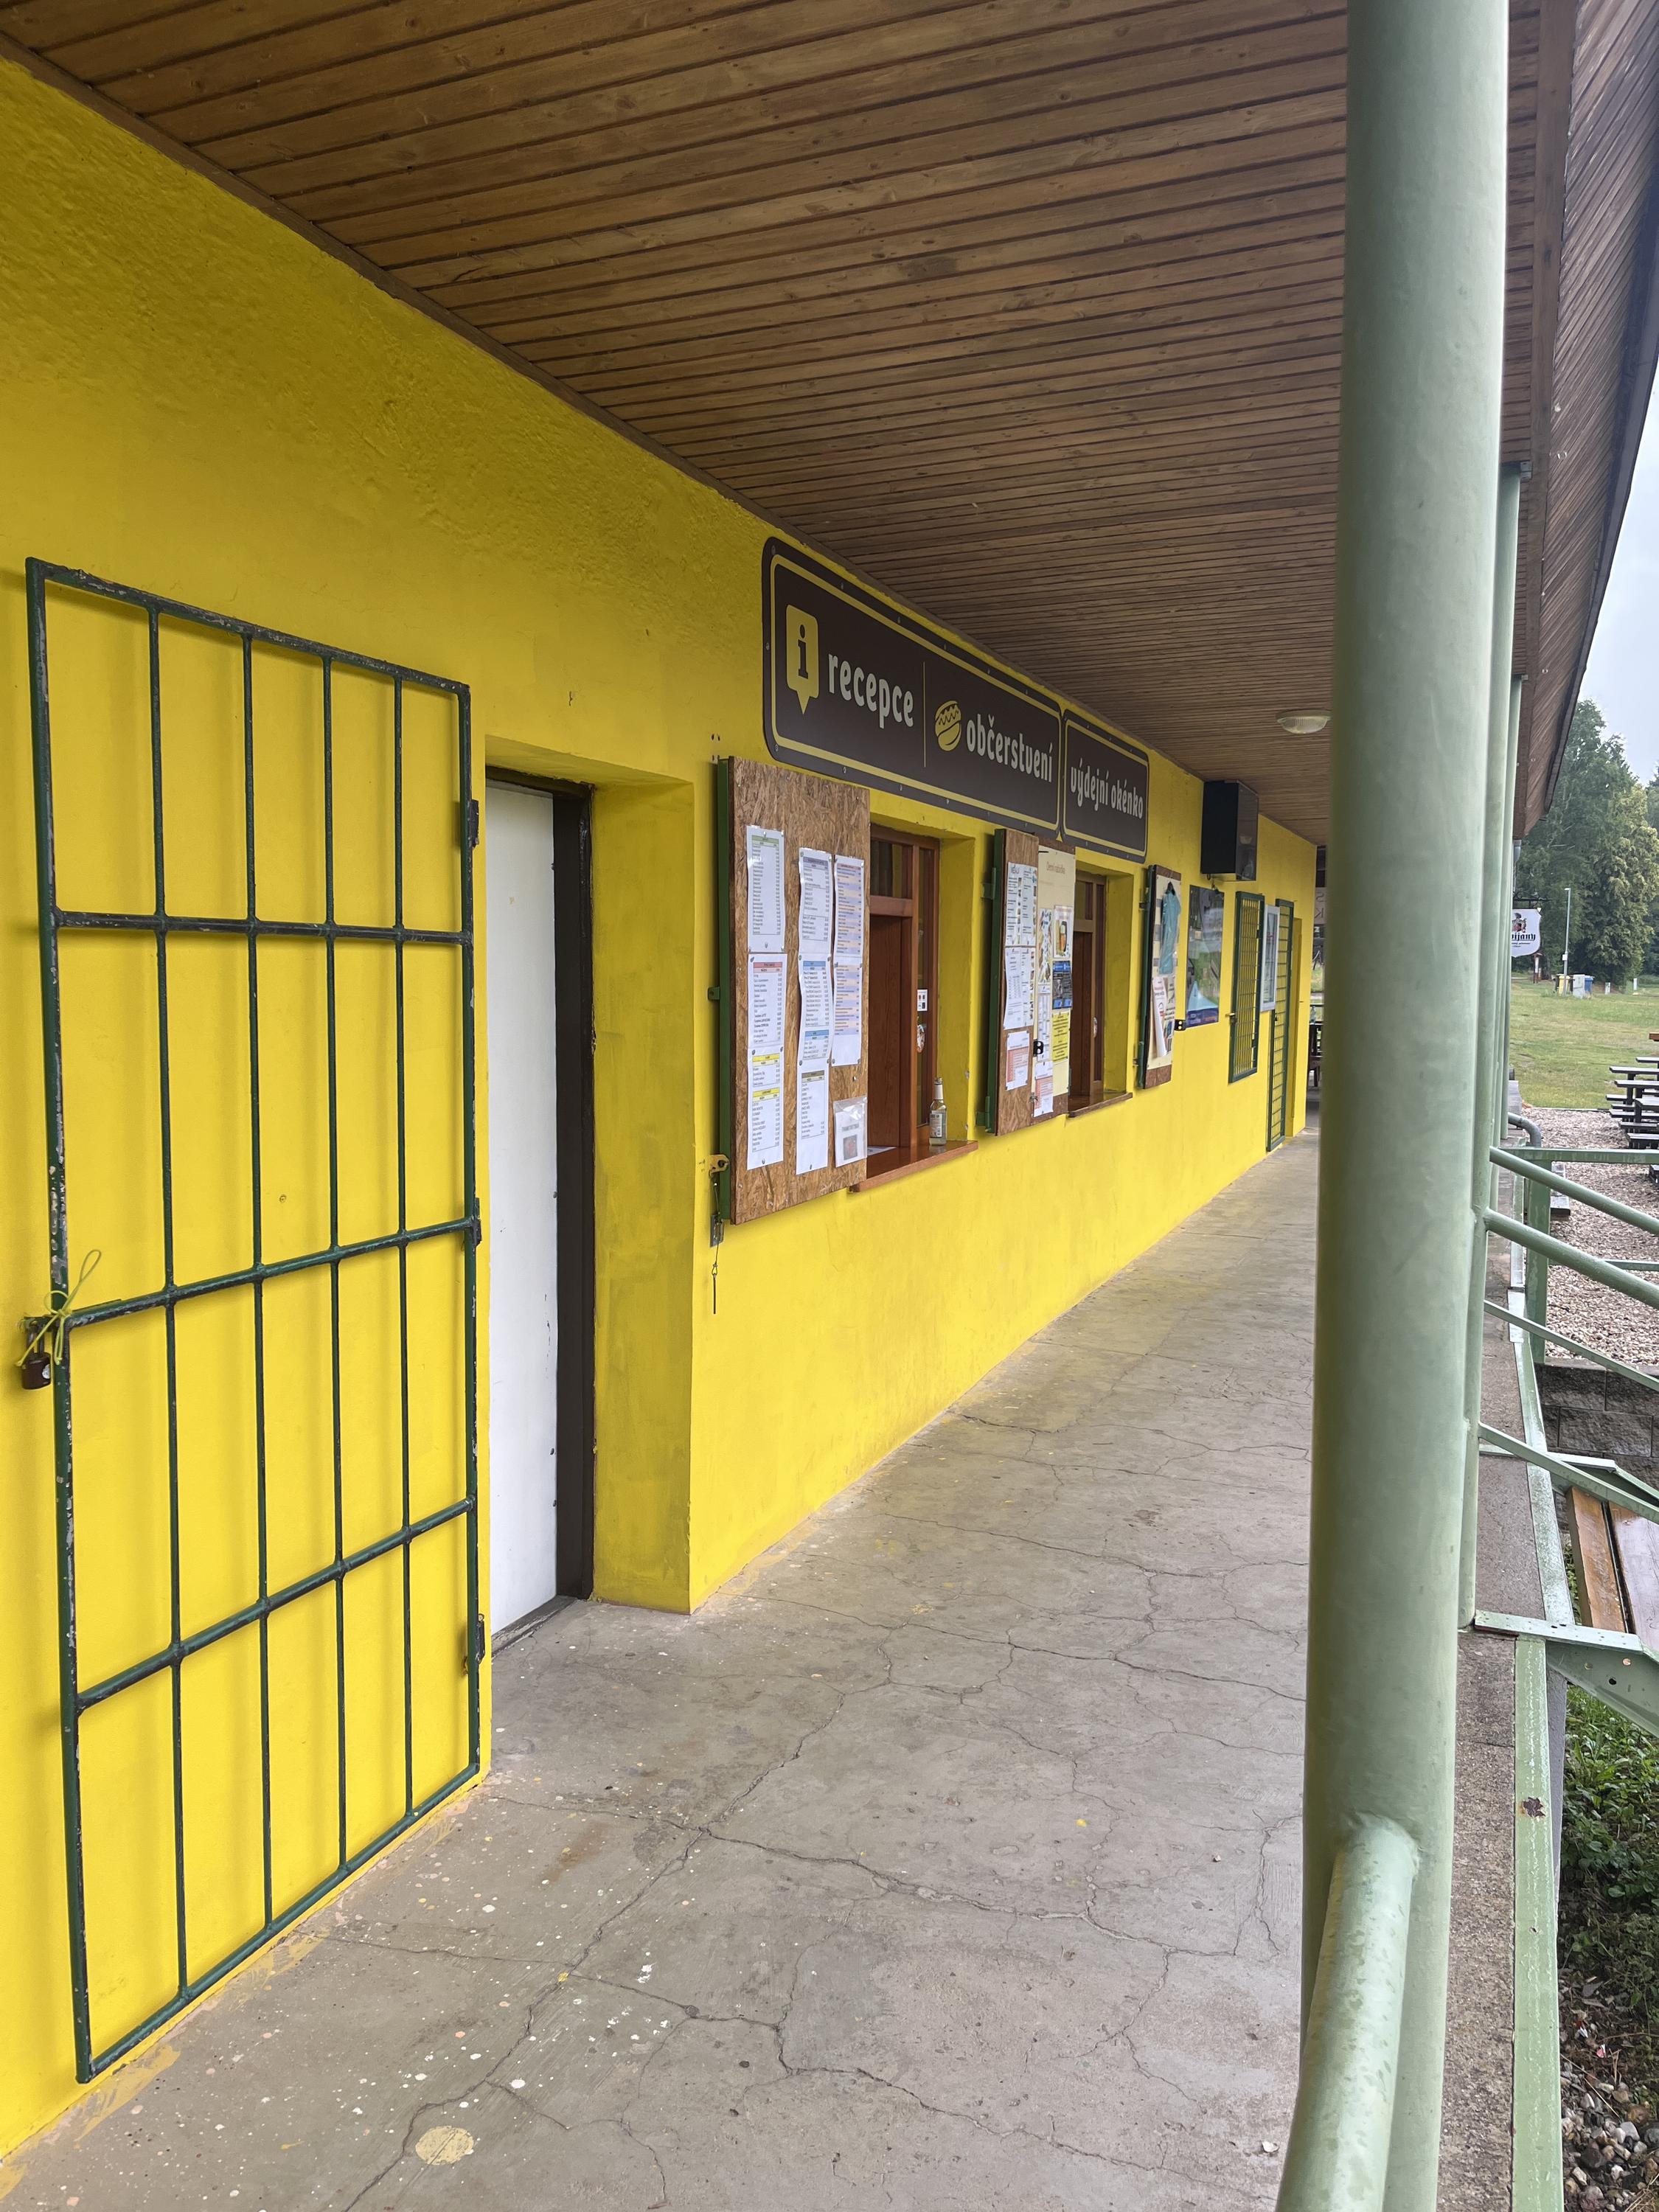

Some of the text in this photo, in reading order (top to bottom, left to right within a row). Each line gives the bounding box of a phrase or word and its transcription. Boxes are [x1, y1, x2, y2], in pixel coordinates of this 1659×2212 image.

[828, 653, 914, 728] recepce
[967, 713, 1052, 782] občerstvení
[1071, 757, 1143, 819] výdejní okénko
